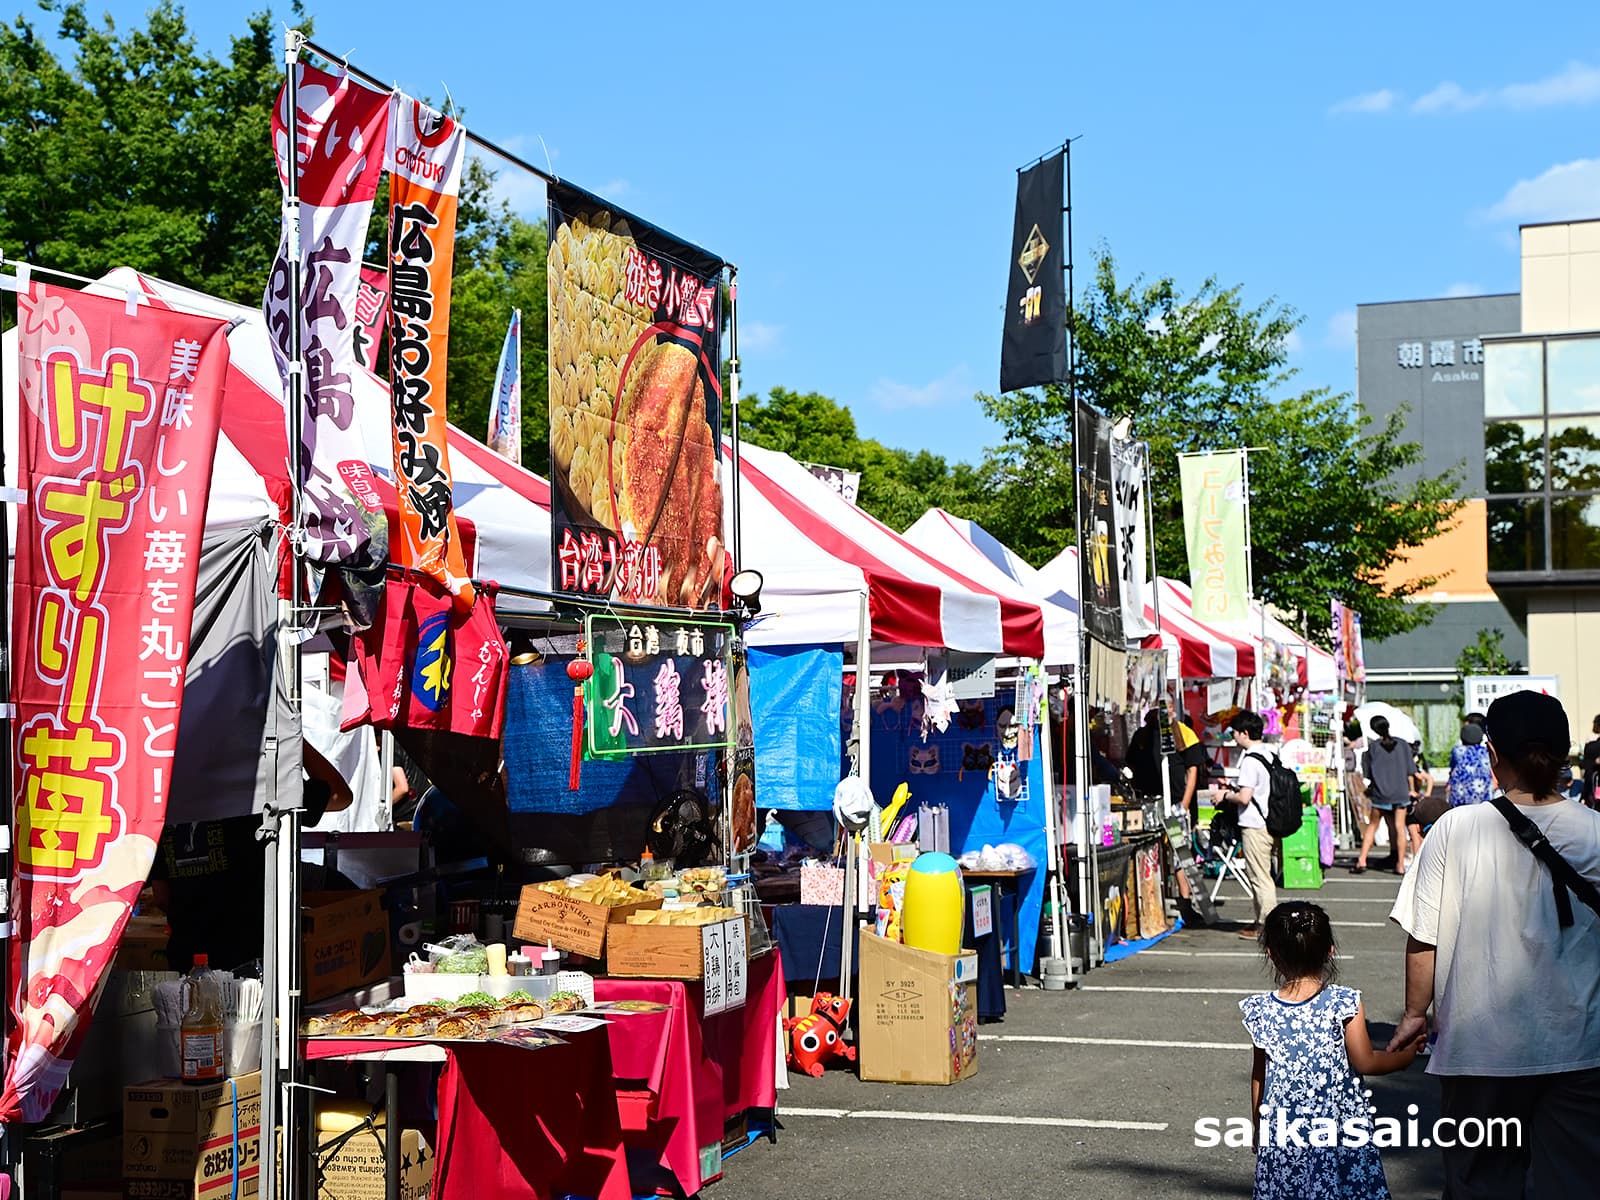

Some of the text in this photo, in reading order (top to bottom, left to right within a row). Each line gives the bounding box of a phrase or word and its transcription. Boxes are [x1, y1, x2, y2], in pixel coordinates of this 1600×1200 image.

[137, 338, 203, 804] 美味しい苺を丸ごと！
[1432, 370, 1479, 382] Asaka
[14, 346, 156, 883] けずり苺
